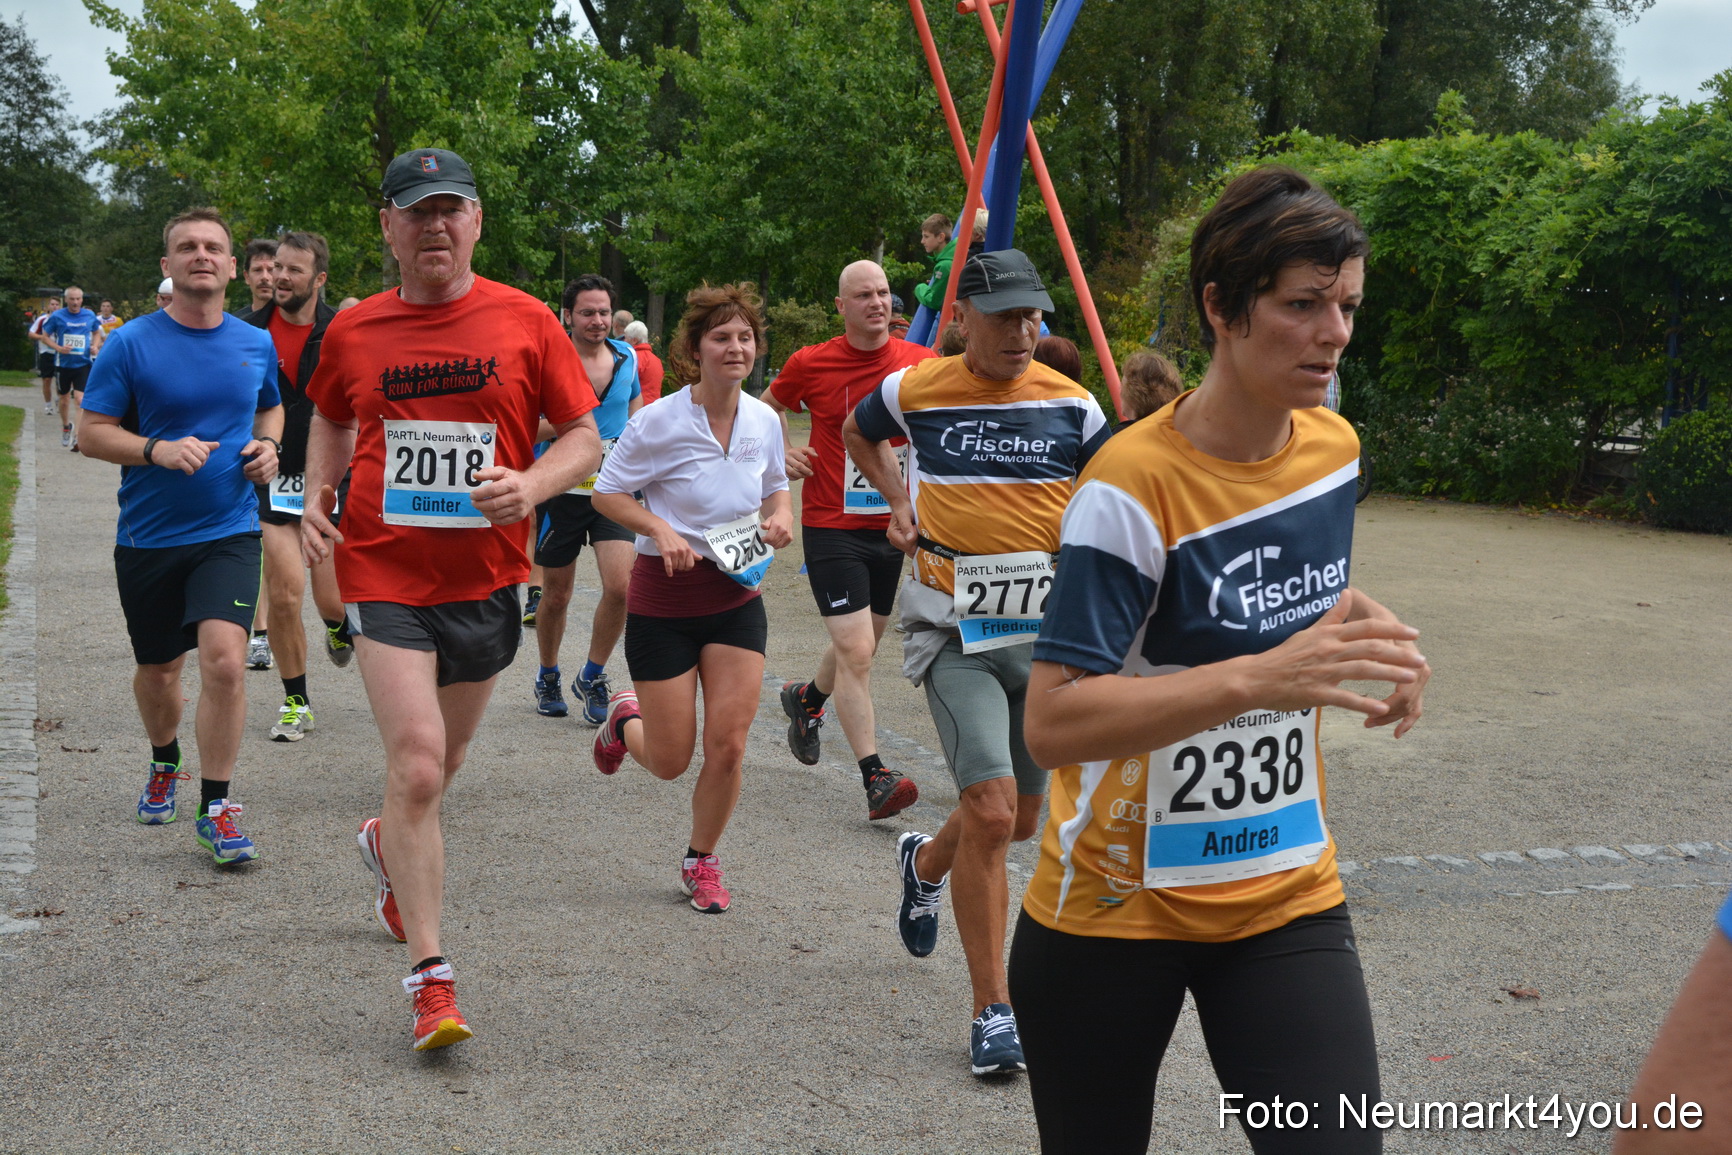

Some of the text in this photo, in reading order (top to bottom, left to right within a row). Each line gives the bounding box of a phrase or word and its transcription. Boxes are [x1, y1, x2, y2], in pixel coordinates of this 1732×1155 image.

[995, 271, 1016, 280] JAKO
[388, 373, 480, 397] RUN FOR BÜRNI
[387, 430, 477, 443] PARTL Neumarkt
[961, 434, 1056, 453] Fischer
[394, 446, 484, 488] 2018
[970, 454, 1049, 464] AUTOMOBILE
[412, 495, 461, 513] Günter
[709, 531, 736, 546] PARTL
[957, 561, 1047, 577] PARTL Neumarkt
[967, 575, 1055, 616] 2772
[1238, 557, 1347, 618] Fischer
[1169, 727, 1304, 814] 2338
[1154, 811, 1162, 823] B
[1104, 823, 1130, 834] Audi
[1201, 825, 1279, 858] Andrea
